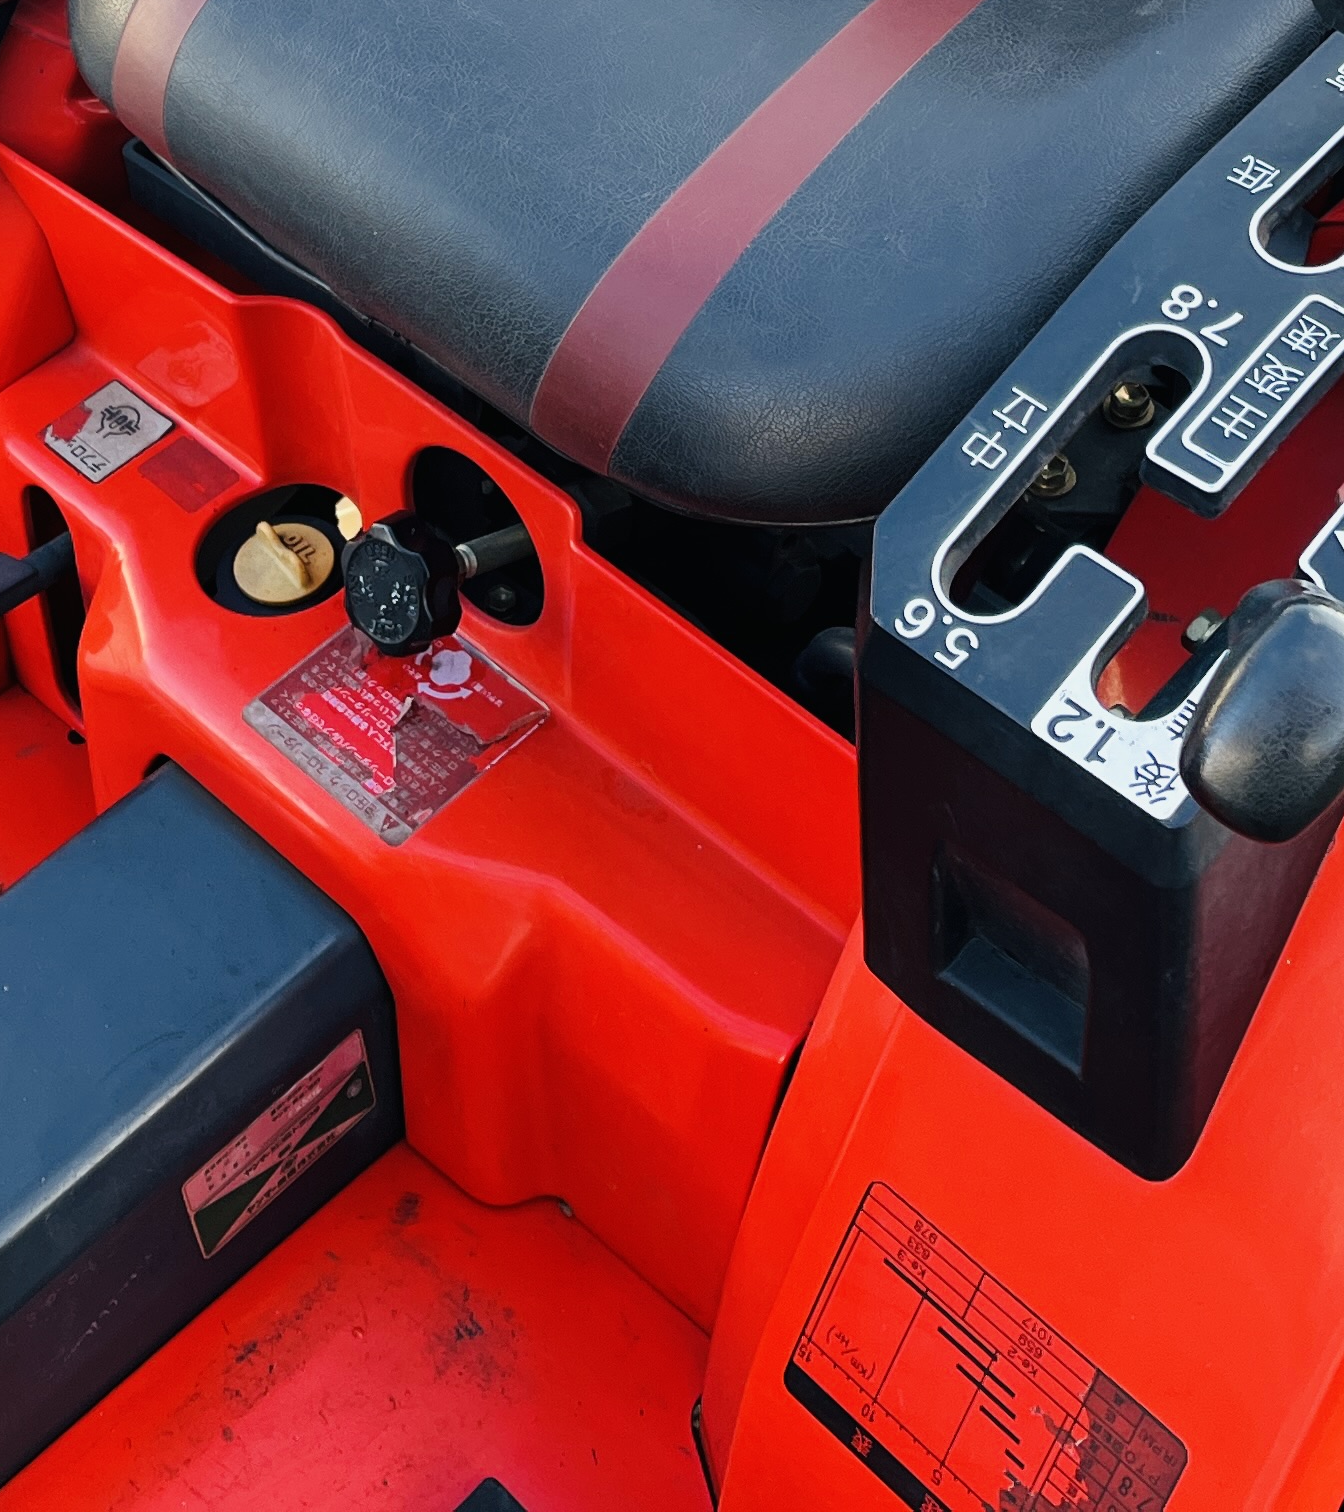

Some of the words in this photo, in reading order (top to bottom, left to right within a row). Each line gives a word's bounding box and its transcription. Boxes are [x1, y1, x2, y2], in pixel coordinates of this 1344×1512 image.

[1227, 155, 1280, 194] 低
[1161, 285, 1243, 346] 7.8
[1212, 315, 1340, 440] 主変速
[963, 387, 1048, 469] 中立
[895, 598, 979, 670] 5.6
[1047, 697, 1117, 764] 1.2
[1022, 1317, 1053, 1346] 1017
[798, 1344, 812, 1362] 15
[1007, 1346, 1038, 1378] Ke-2
[861, 1403, 876, 1422] 10
[931, 1468, 942, 1486] 5
